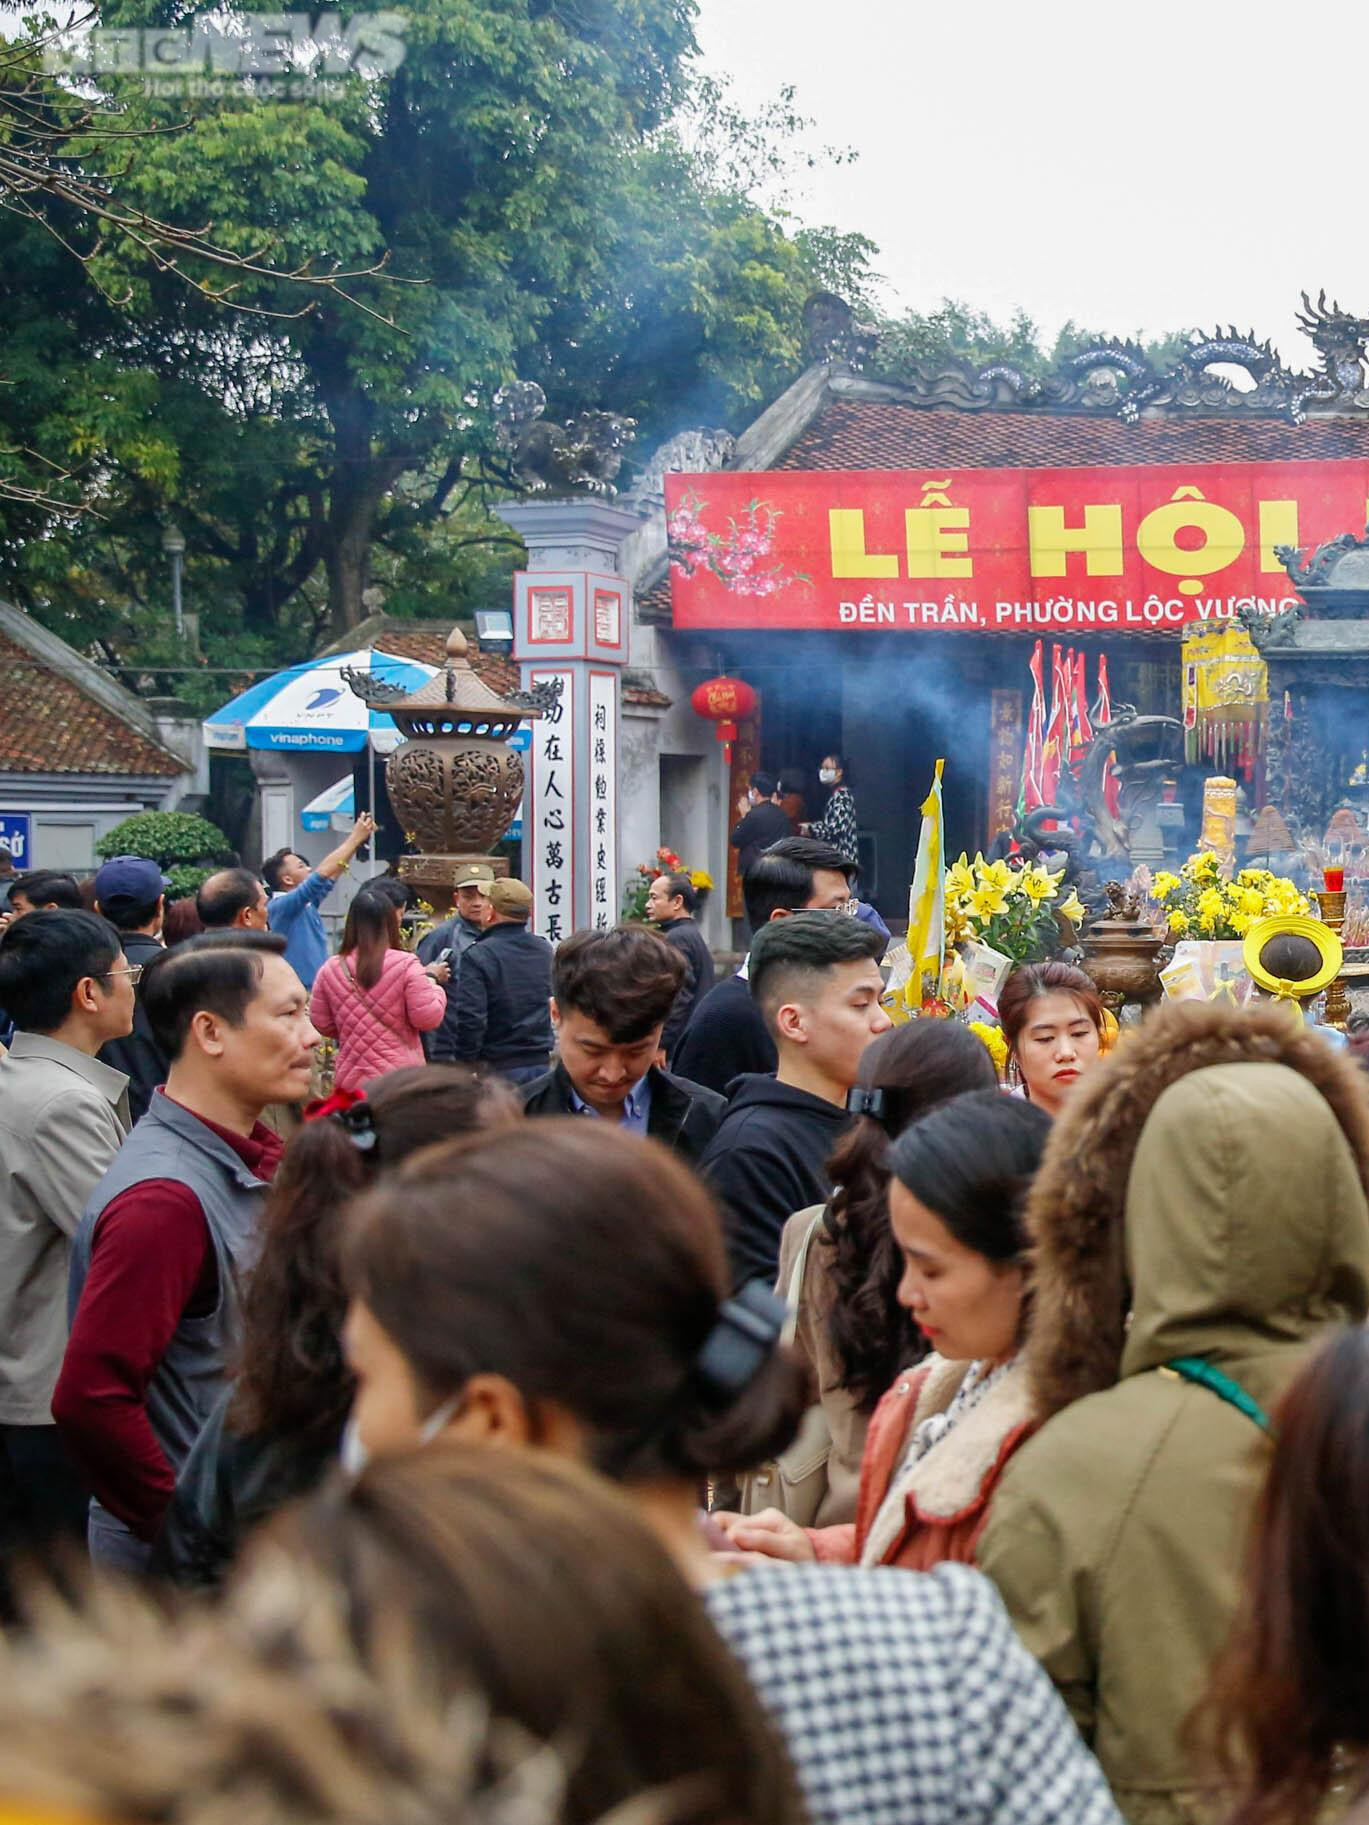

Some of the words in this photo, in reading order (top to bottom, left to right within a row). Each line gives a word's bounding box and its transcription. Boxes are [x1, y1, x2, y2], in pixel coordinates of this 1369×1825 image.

[829, 478, 974, 579] LỄ
[1028, 485, 1300, 597] HỘI
[838, 592, 896, 624] ĐỀN
[903, 593, 987, 629] TRẦN,
[995, 594, 1118, 624] PHƯỜNG
[1125, 594, 1185, 627] LỘC
[269, 729, 345, 747] vinaphone
